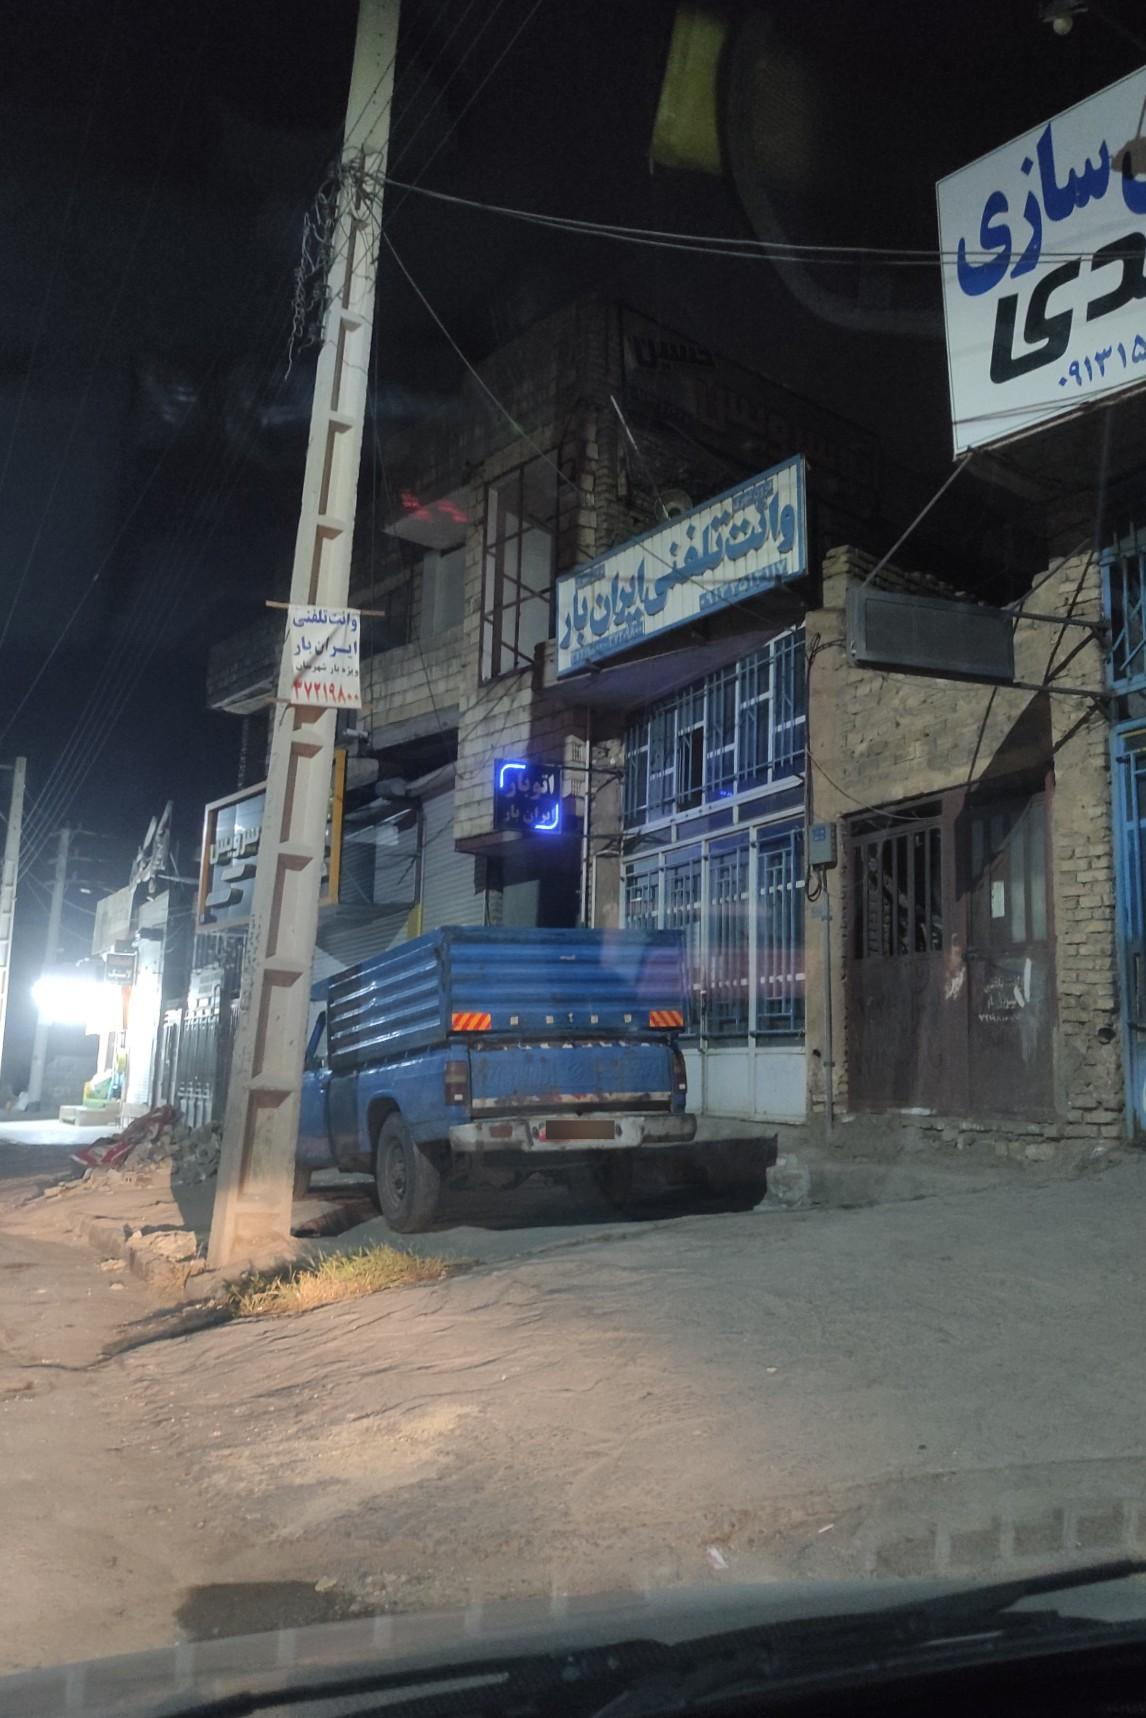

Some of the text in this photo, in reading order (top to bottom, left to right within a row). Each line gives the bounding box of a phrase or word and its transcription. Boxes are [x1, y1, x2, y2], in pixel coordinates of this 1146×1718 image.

[957, 122, 1111, 296] سازی
[724, 490, 796, 560] وانت
[643, 509, 730, 616] تلفنی
[293, 608, 358, 632] وانت تلفنی
[559, 585, 588, 650] بار
[589, 556, 646, 637] ایران
[294, 636, 358, 658] ایران بار
[330, 664, 340, 674] بار
[293, 678, 359, 704] ۳۷۲۱۹۸۰۰
[210, 826, 261, 865] سرویس
